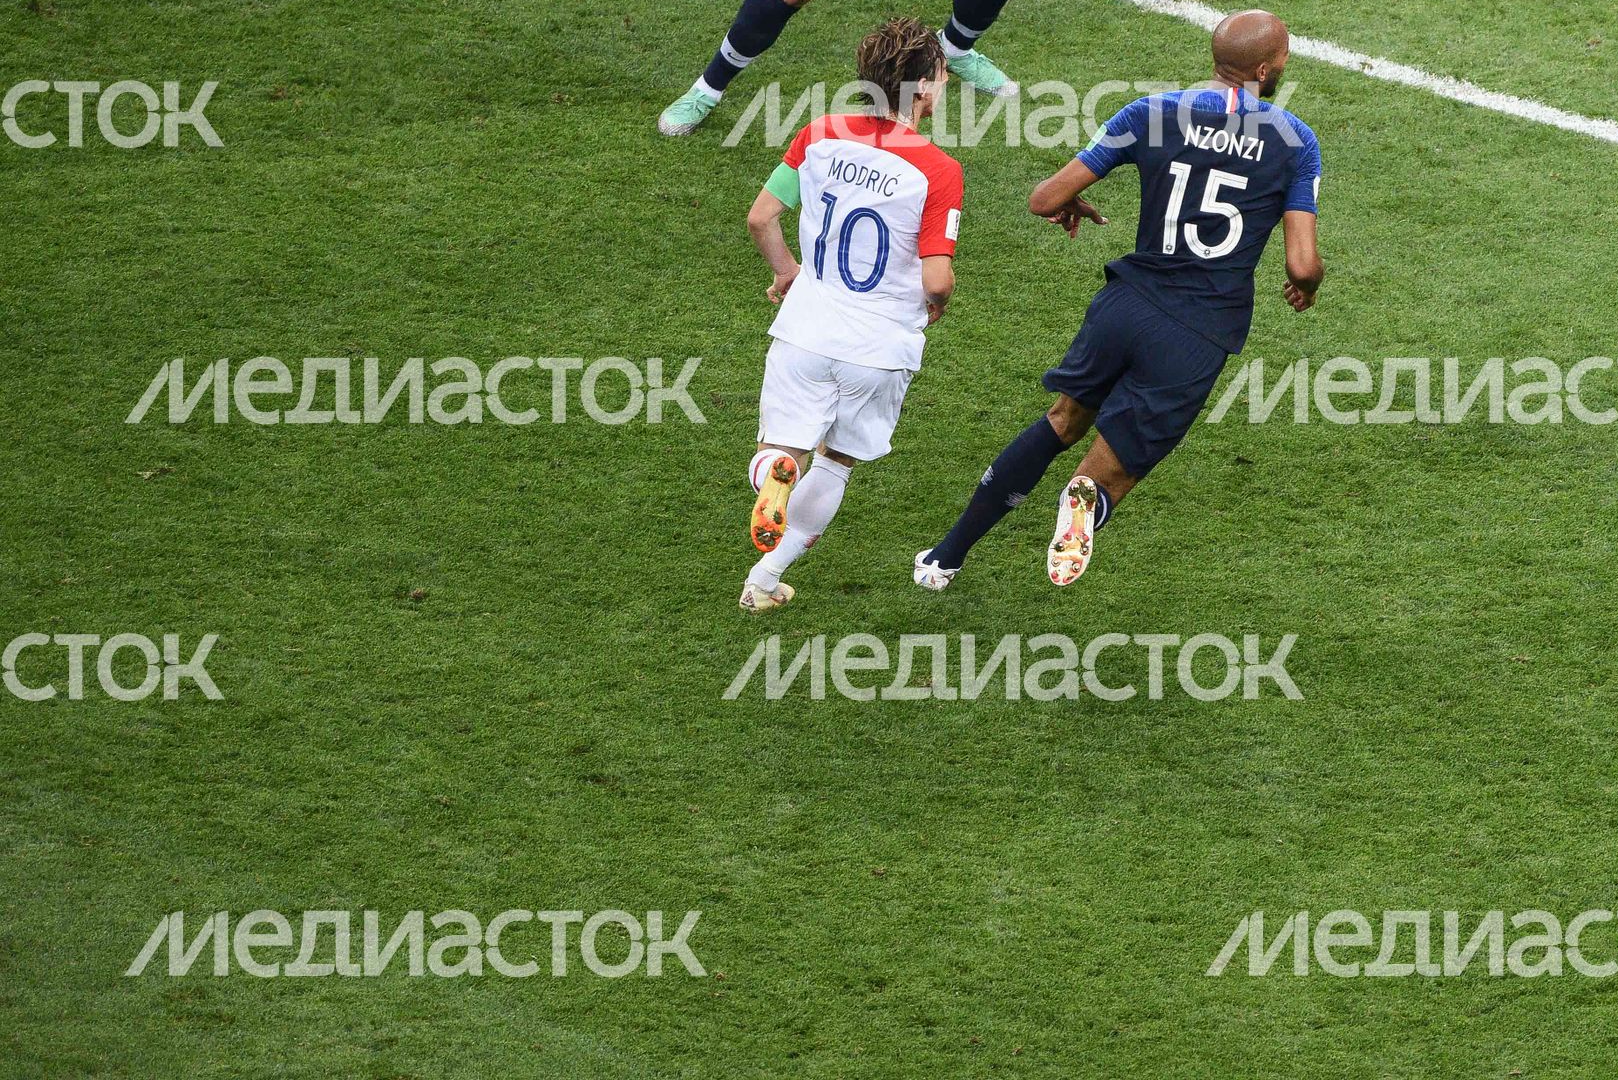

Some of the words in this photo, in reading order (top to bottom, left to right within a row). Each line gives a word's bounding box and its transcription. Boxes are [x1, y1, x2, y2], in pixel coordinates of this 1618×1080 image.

[827, 157, 902, 198] MODRIĆ
[1184, 123, 1265, 162] NZONZI
[814, 191, 890, 293] 10
[1162, 161, 1249, 260] 15
